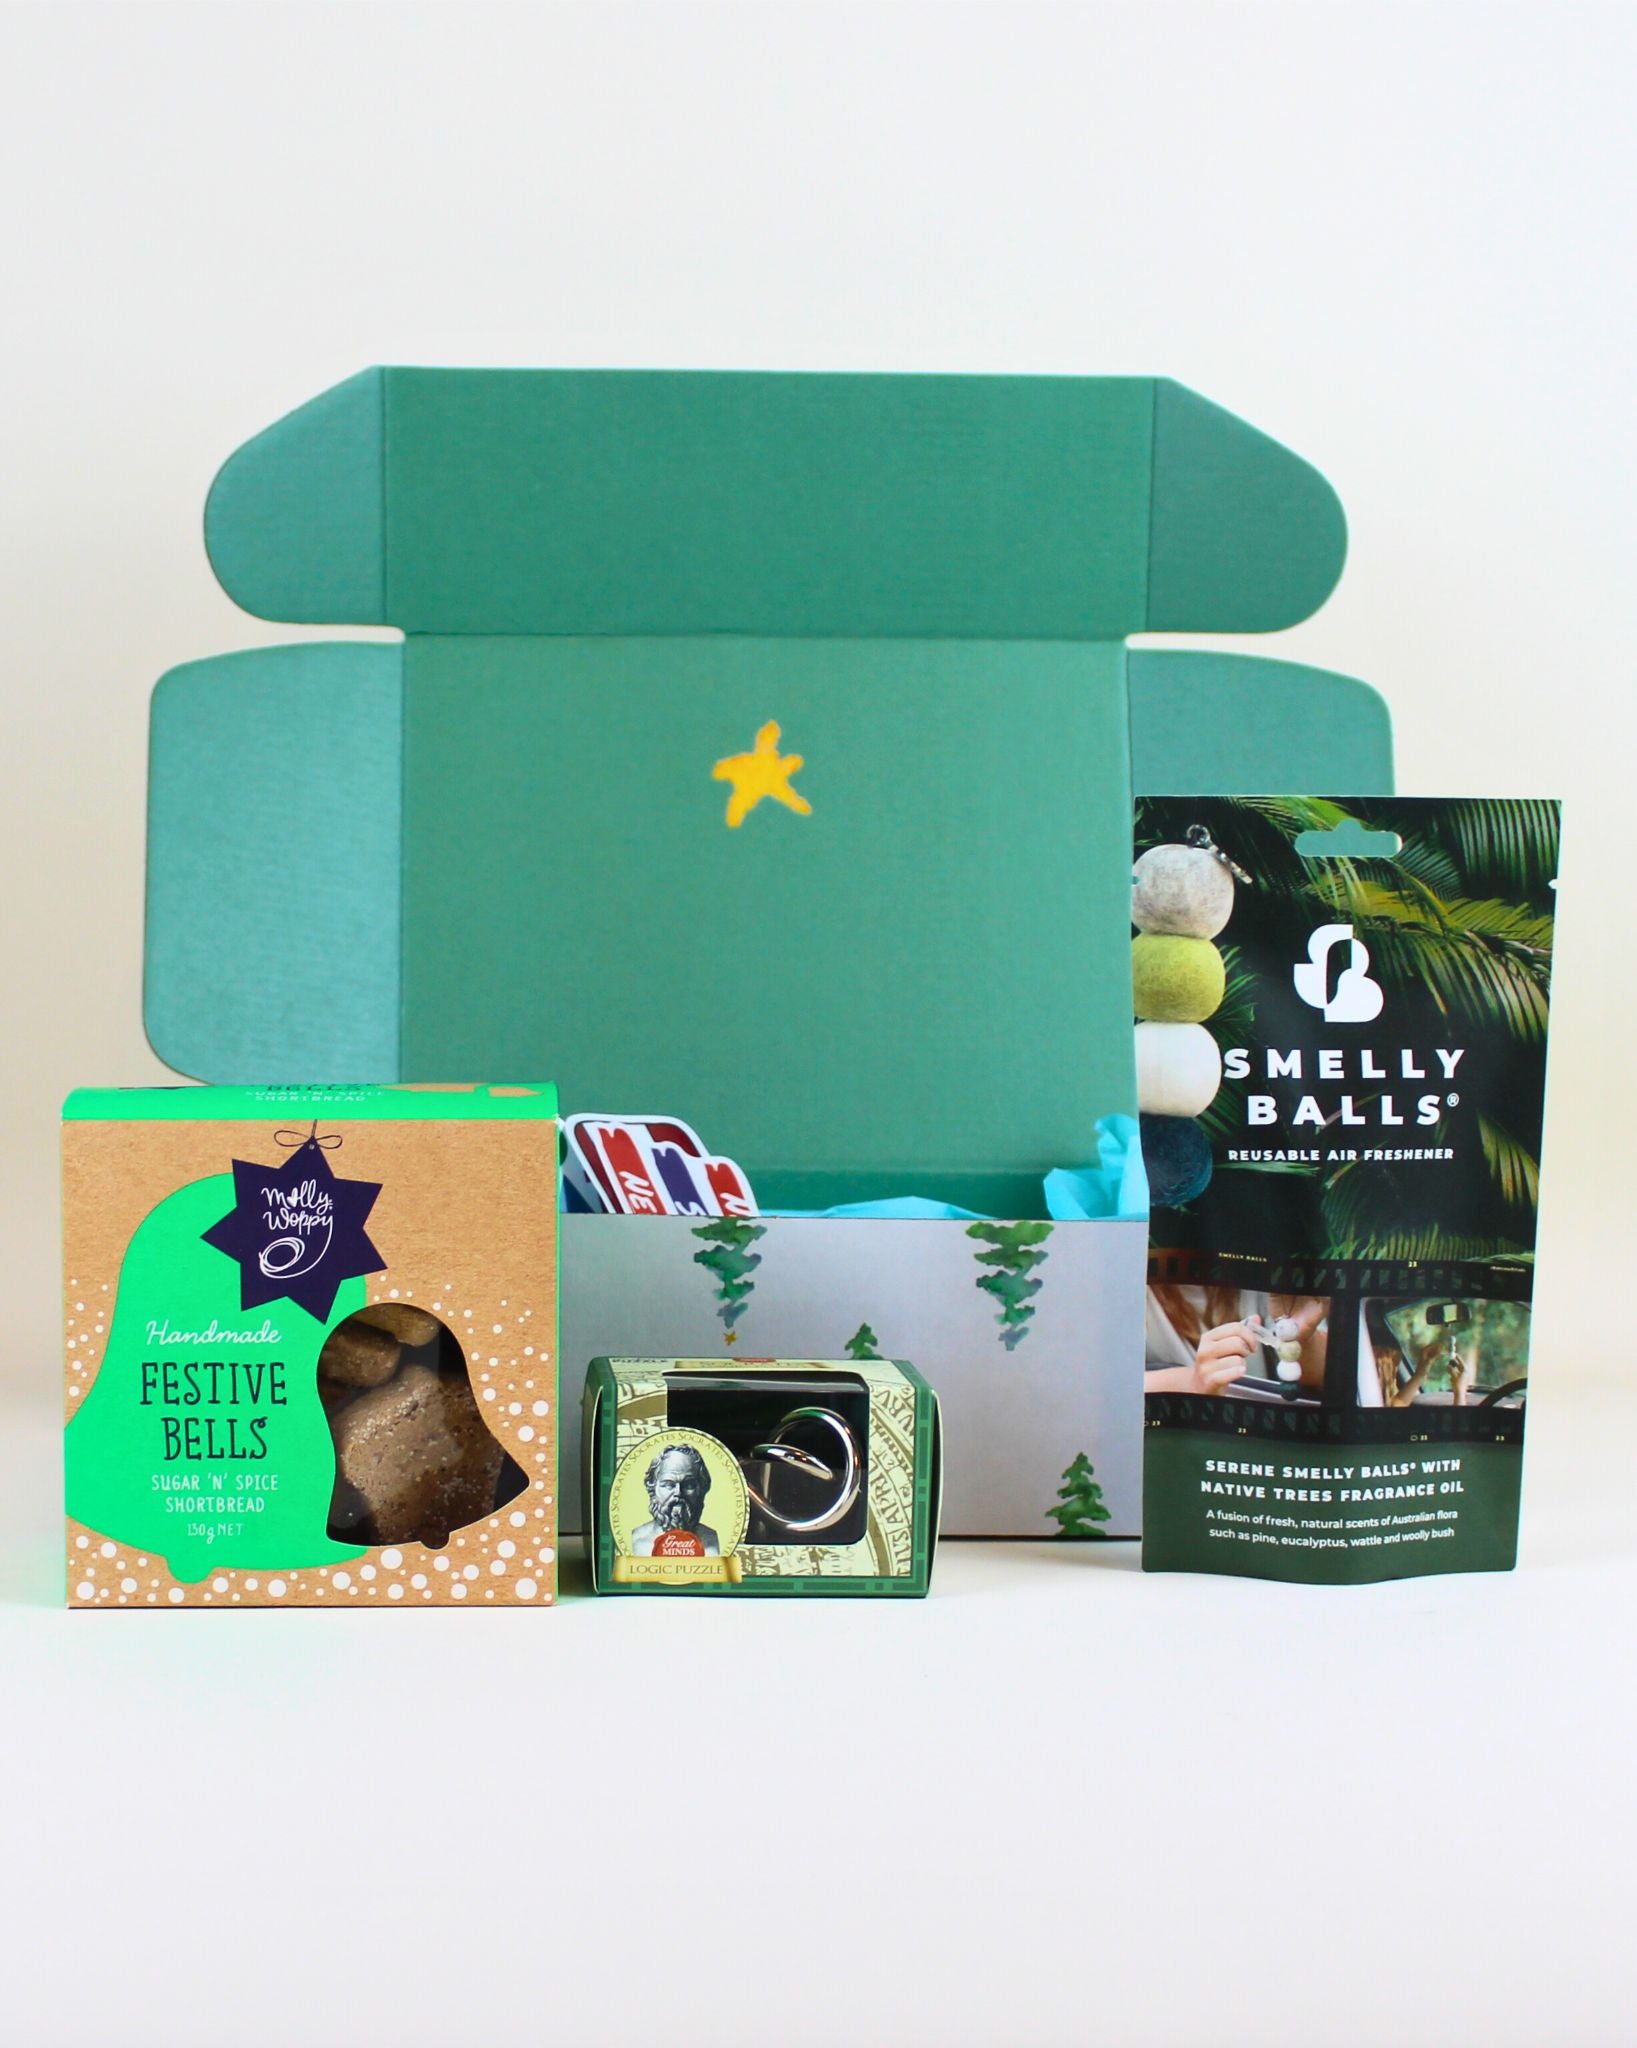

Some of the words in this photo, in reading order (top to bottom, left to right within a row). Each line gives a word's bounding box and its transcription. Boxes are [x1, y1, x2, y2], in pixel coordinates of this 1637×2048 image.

[1223, 1048, 1465, 1080] SMELLY
[1228, 1149, 1320, 1162] REUSABLE
[1326, 1149, 1357, 1161] AIR
[1363, 1148, 1454, 1161] FRESHENER
[145, 1319, 282, 1346] Handmade
[140, 1361, 288, 1406] FESTIVE
[160, 1416, 268, 1461] BELLS
[1205, 1459, 1275, 1478] SERENE
[1282, 1466, 1355, 1480] SMELLY
[1421, 1458, 1461, 1474] WITH
[151, 1474, 201, 1491] SUGAR
[235, 1474, 278, 1491] SPICE
[1200, 1480, 1266, 1498] NATIVE
[1273, 1487, 1332, 1503] TREES
[1340, 1483, 1435, 1502] FRAGRANCE
[1440, 1480, 1465, 1494] OIL
[165, 1496, 265, 1513] SHORTBREAD
[217, 1522, 244, 1537] NET
[1205, 1509, 1215, 1519] A
[1216, 1509, 1250, 1523] fusion
[1252, 1514, 1264, 1525] of
[1265, 1515, 1298, 1529] fresh,
[1300, 1518, 1343, 1530] natural
[1345, 1517, 1379, 1529] scents
[1380, 1515, 1391, 1526] of
[1391, 1511, 1435, 1525] Australian
[1436, 1509, 1459, 1520] flora
[661, 1534, 696, 1548] Great
[1209, 1528, 1235, 1539] such
[1237, 1531, 1251, 1541] as
[1252, 1532, 1280, 1545] pine,
[1281, 1536, 1348, 1550] eucalyptus,
[1350, 1534, 1382, 1548] wattle
[1383, 1532, 1401, 1545] and
[1401, 1528, 1430, 1542] woolly
[1431, 1526, 1455, 1539] bush
[661, 1547, 696, 1556] MINDS
[629, 1564, 673, 1575] LOGIC
[675, 1564, 724, 1575] PUZZLE
